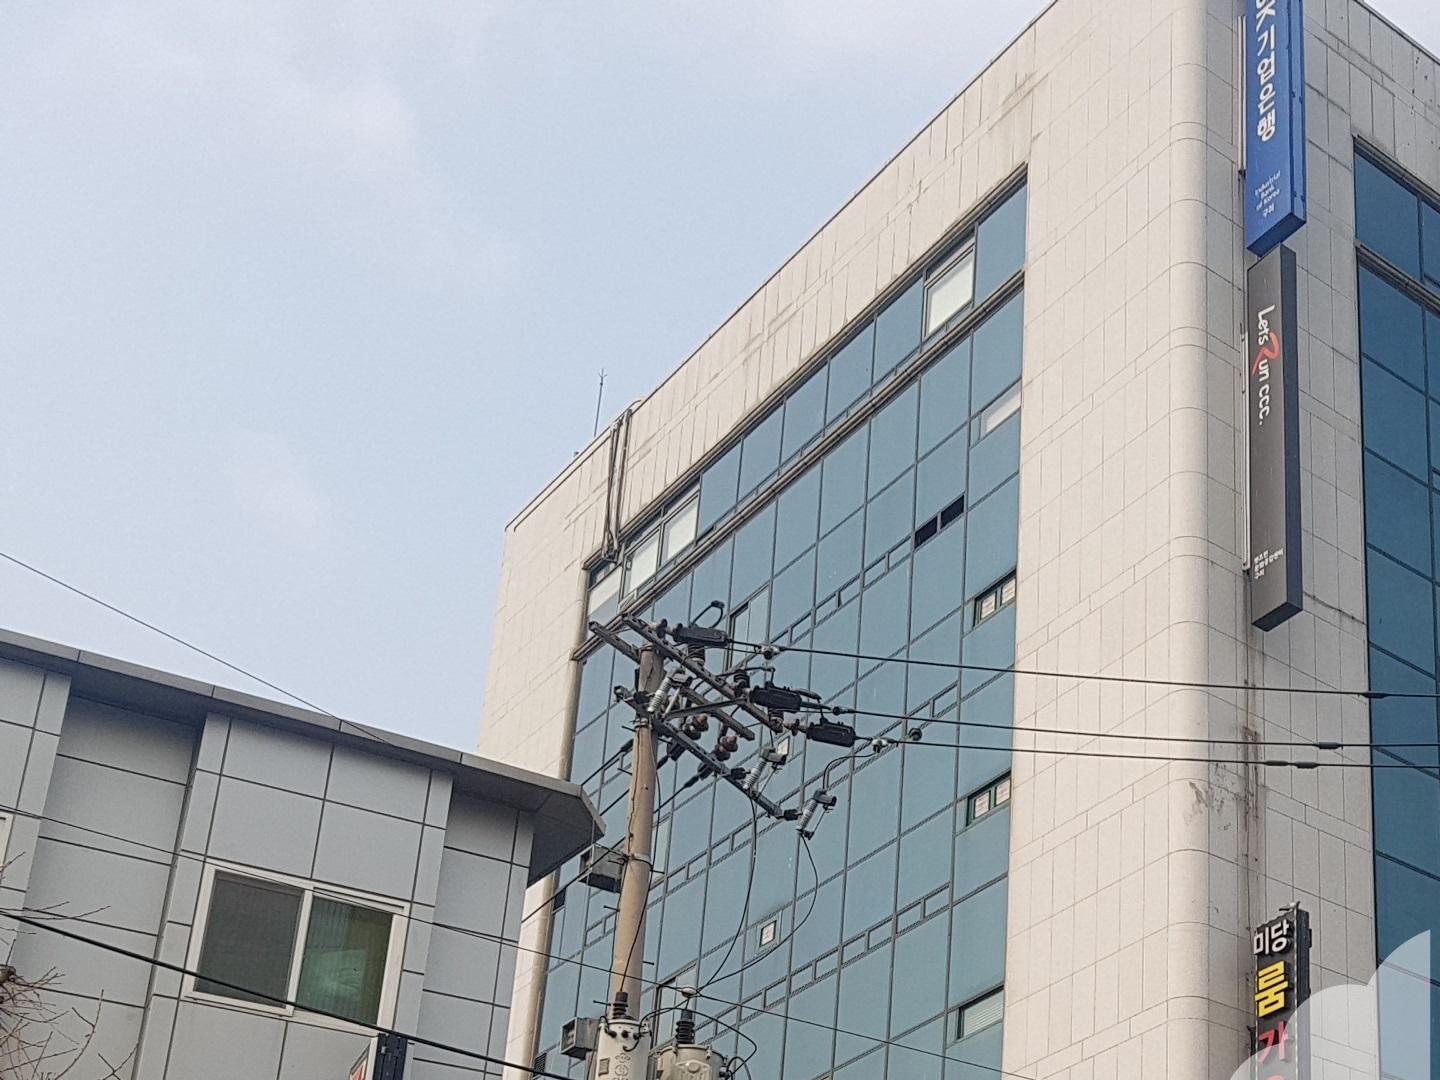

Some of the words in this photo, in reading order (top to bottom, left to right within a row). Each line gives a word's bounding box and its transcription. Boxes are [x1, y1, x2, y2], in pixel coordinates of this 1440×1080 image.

[1257, 24, 1276, 142] 기업은행
[1253, 920, 1290, 956] 미당
[1254, 960, 1289, 1018] 룸
